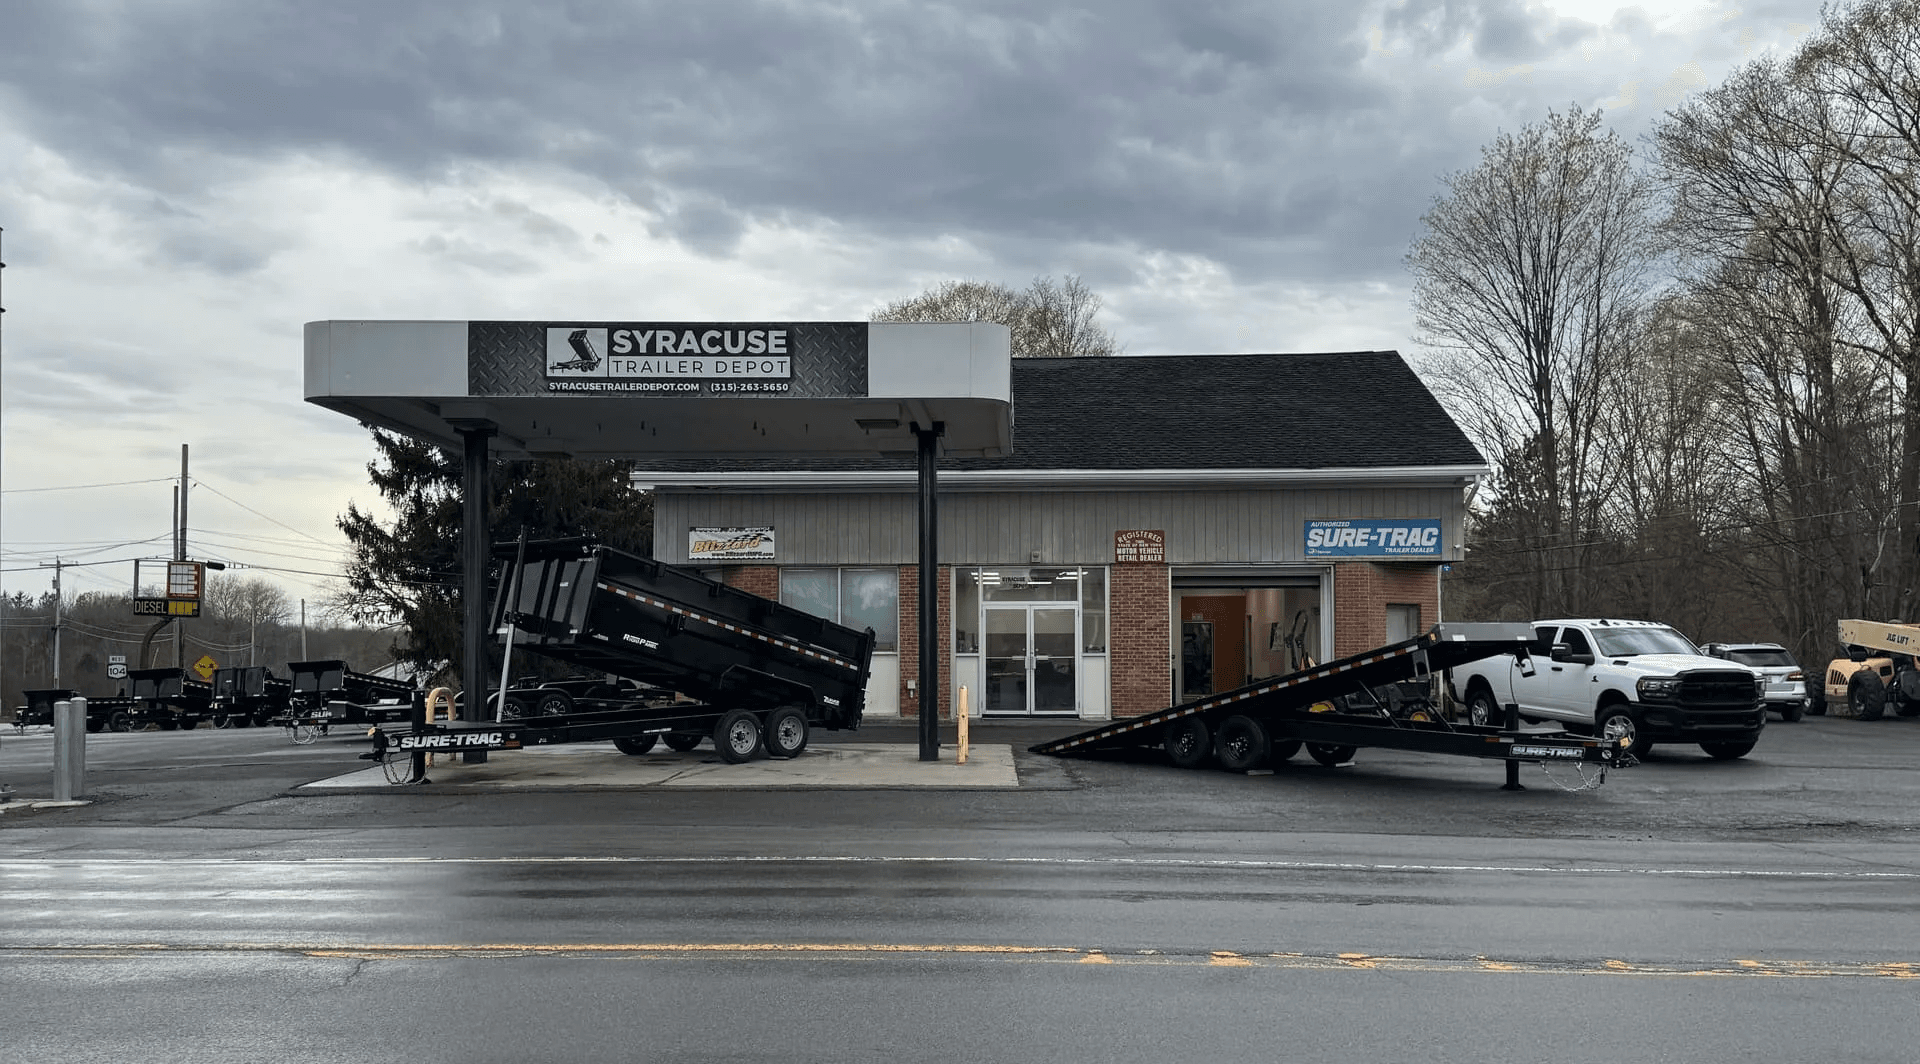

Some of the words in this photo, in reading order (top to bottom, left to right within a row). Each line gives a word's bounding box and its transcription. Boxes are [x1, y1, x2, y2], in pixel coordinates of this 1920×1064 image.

[612, 329, 788, 354] SYRACUSE
[612, 360, 704, 374] TRAILER
[715, 360, 788, 374] DEPOT
[549, 382, 700, 392] SYRACUSETRAILERDEPOT.COM
[710, 382, 789, 392] (315)-263-5650
[1118, 531, 1162, 543] REGISTERED
[1307, 528, 1438, 547] SURE-TRAC
[691, 536, 761, 553] Blizzard
[134, 600, 167, 614] DIESEL
[1886, 633, 1896, 642] JLG
[1897, 635, 1909, 645] LIFT
[110, 667, 125, 675] 104
[400, 732, 503, 749] SURE-TRAC
[1512, 746, 1583, 757] SURE-TRAC
